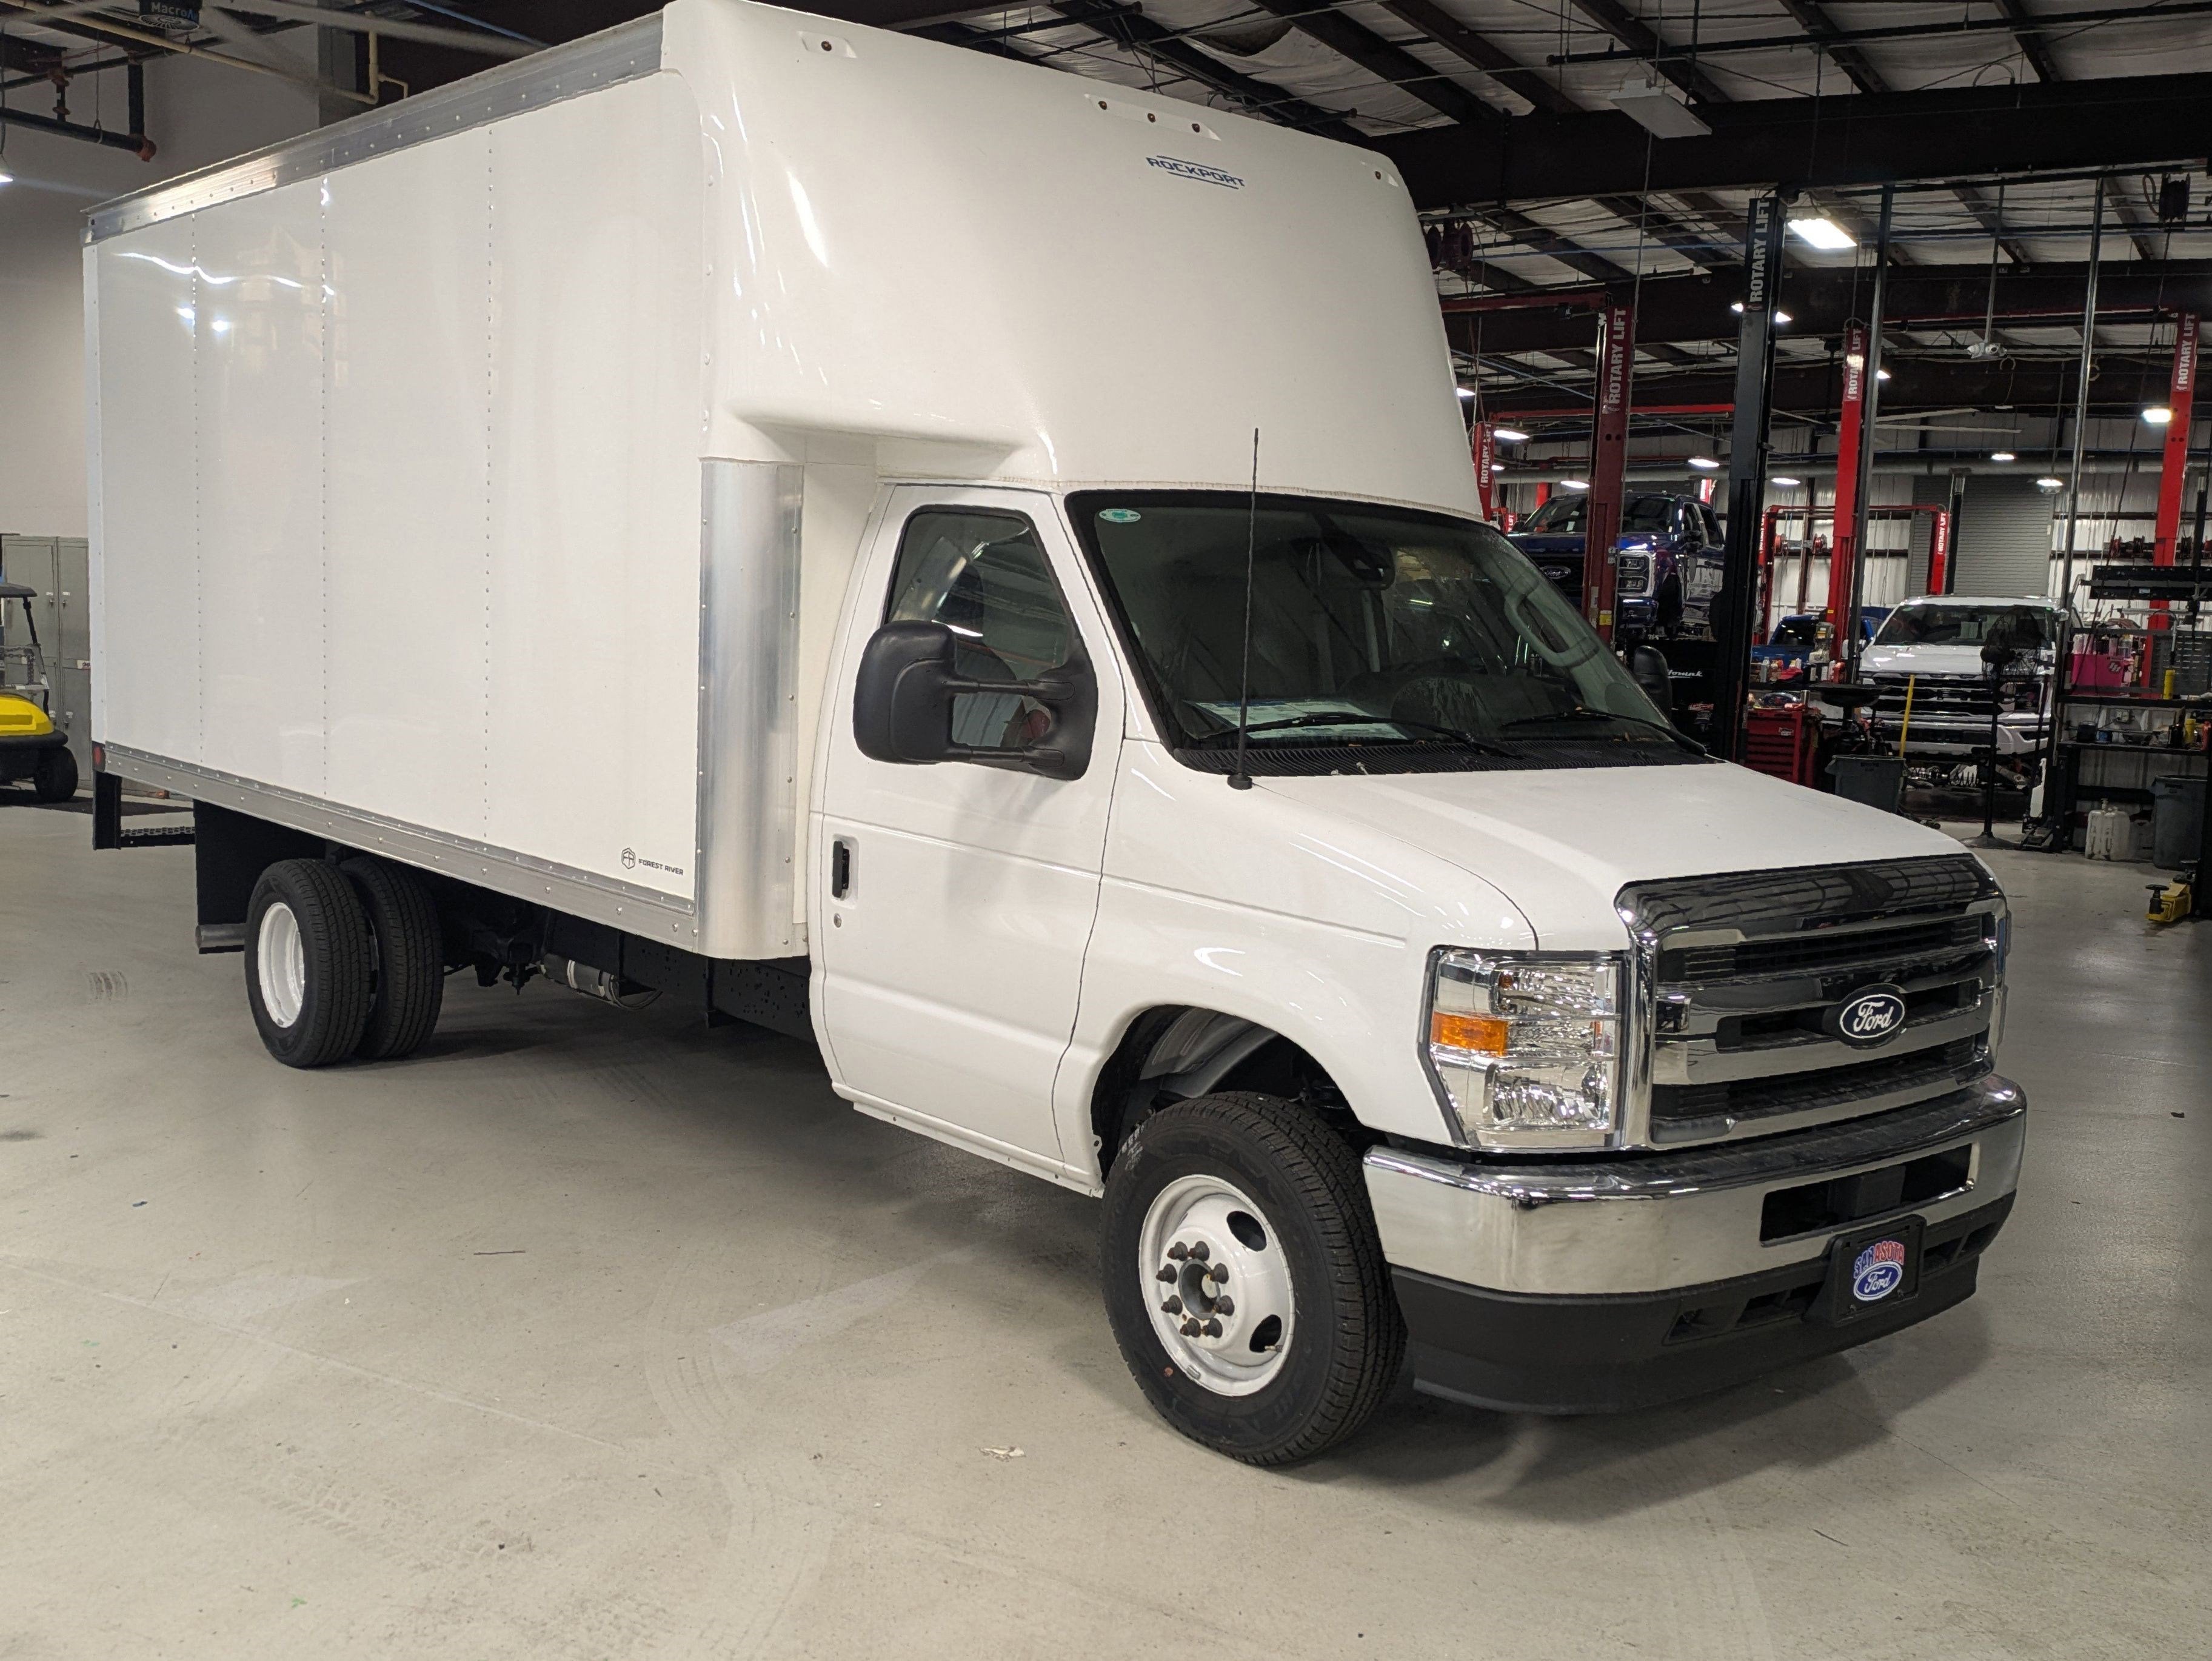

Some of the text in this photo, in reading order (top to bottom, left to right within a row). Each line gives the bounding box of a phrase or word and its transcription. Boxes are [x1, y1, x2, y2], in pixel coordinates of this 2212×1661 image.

[1146, 156, 1245, 186] ROCKPORT
[1749, 199, 1771, 302] ROTARY LIFT
[1609, 308, 1626, 404] ROTARY LIFT
[1848, 328, 1863, 394] ROTA LIFT
[2177, 313, 2196, 384] ROTARY LIFT
[1480, 444, 1491, 484] ROTARY
[638, 858, 684, 875] FOREST RIVER
[1853, 1001, 1894, 1032] Ford
[1854, 1240, 1904, 1279] SARASOTA
[1863, 1269, 1891, 1292] Ford
